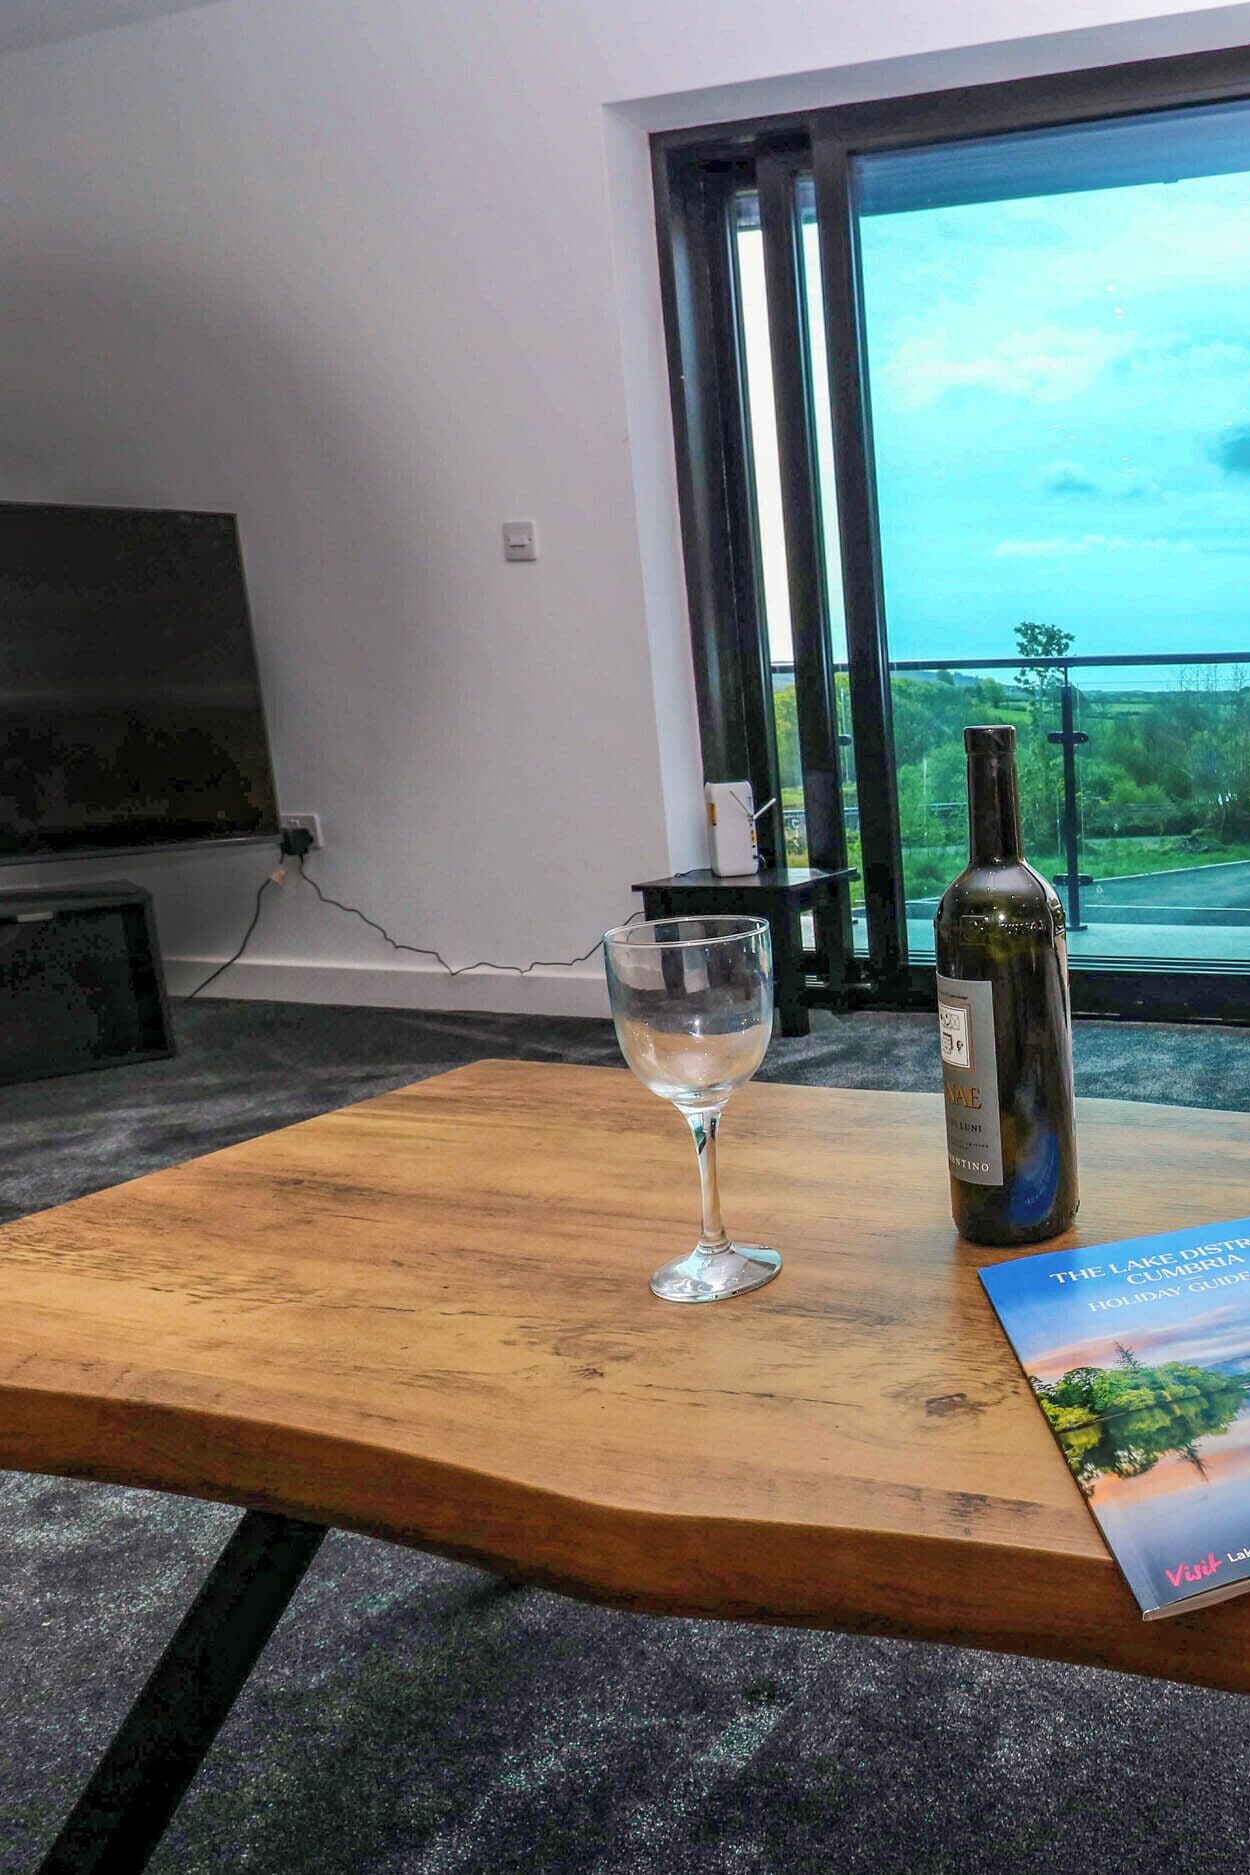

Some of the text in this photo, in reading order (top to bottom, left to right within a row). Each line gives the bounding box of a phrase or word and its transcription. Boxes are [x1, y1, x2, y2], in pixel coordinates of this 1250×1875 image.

[1049, 1266, 1106, 1284] THE
[1109, 1253, 1178, 1275] LAKE
[1126, 1254, 1246, 1285] CUMBRIA
[1088, 1286, 1182, 1312] HOLIDAY
[1165, 1552, 1223, 1587] Visit
